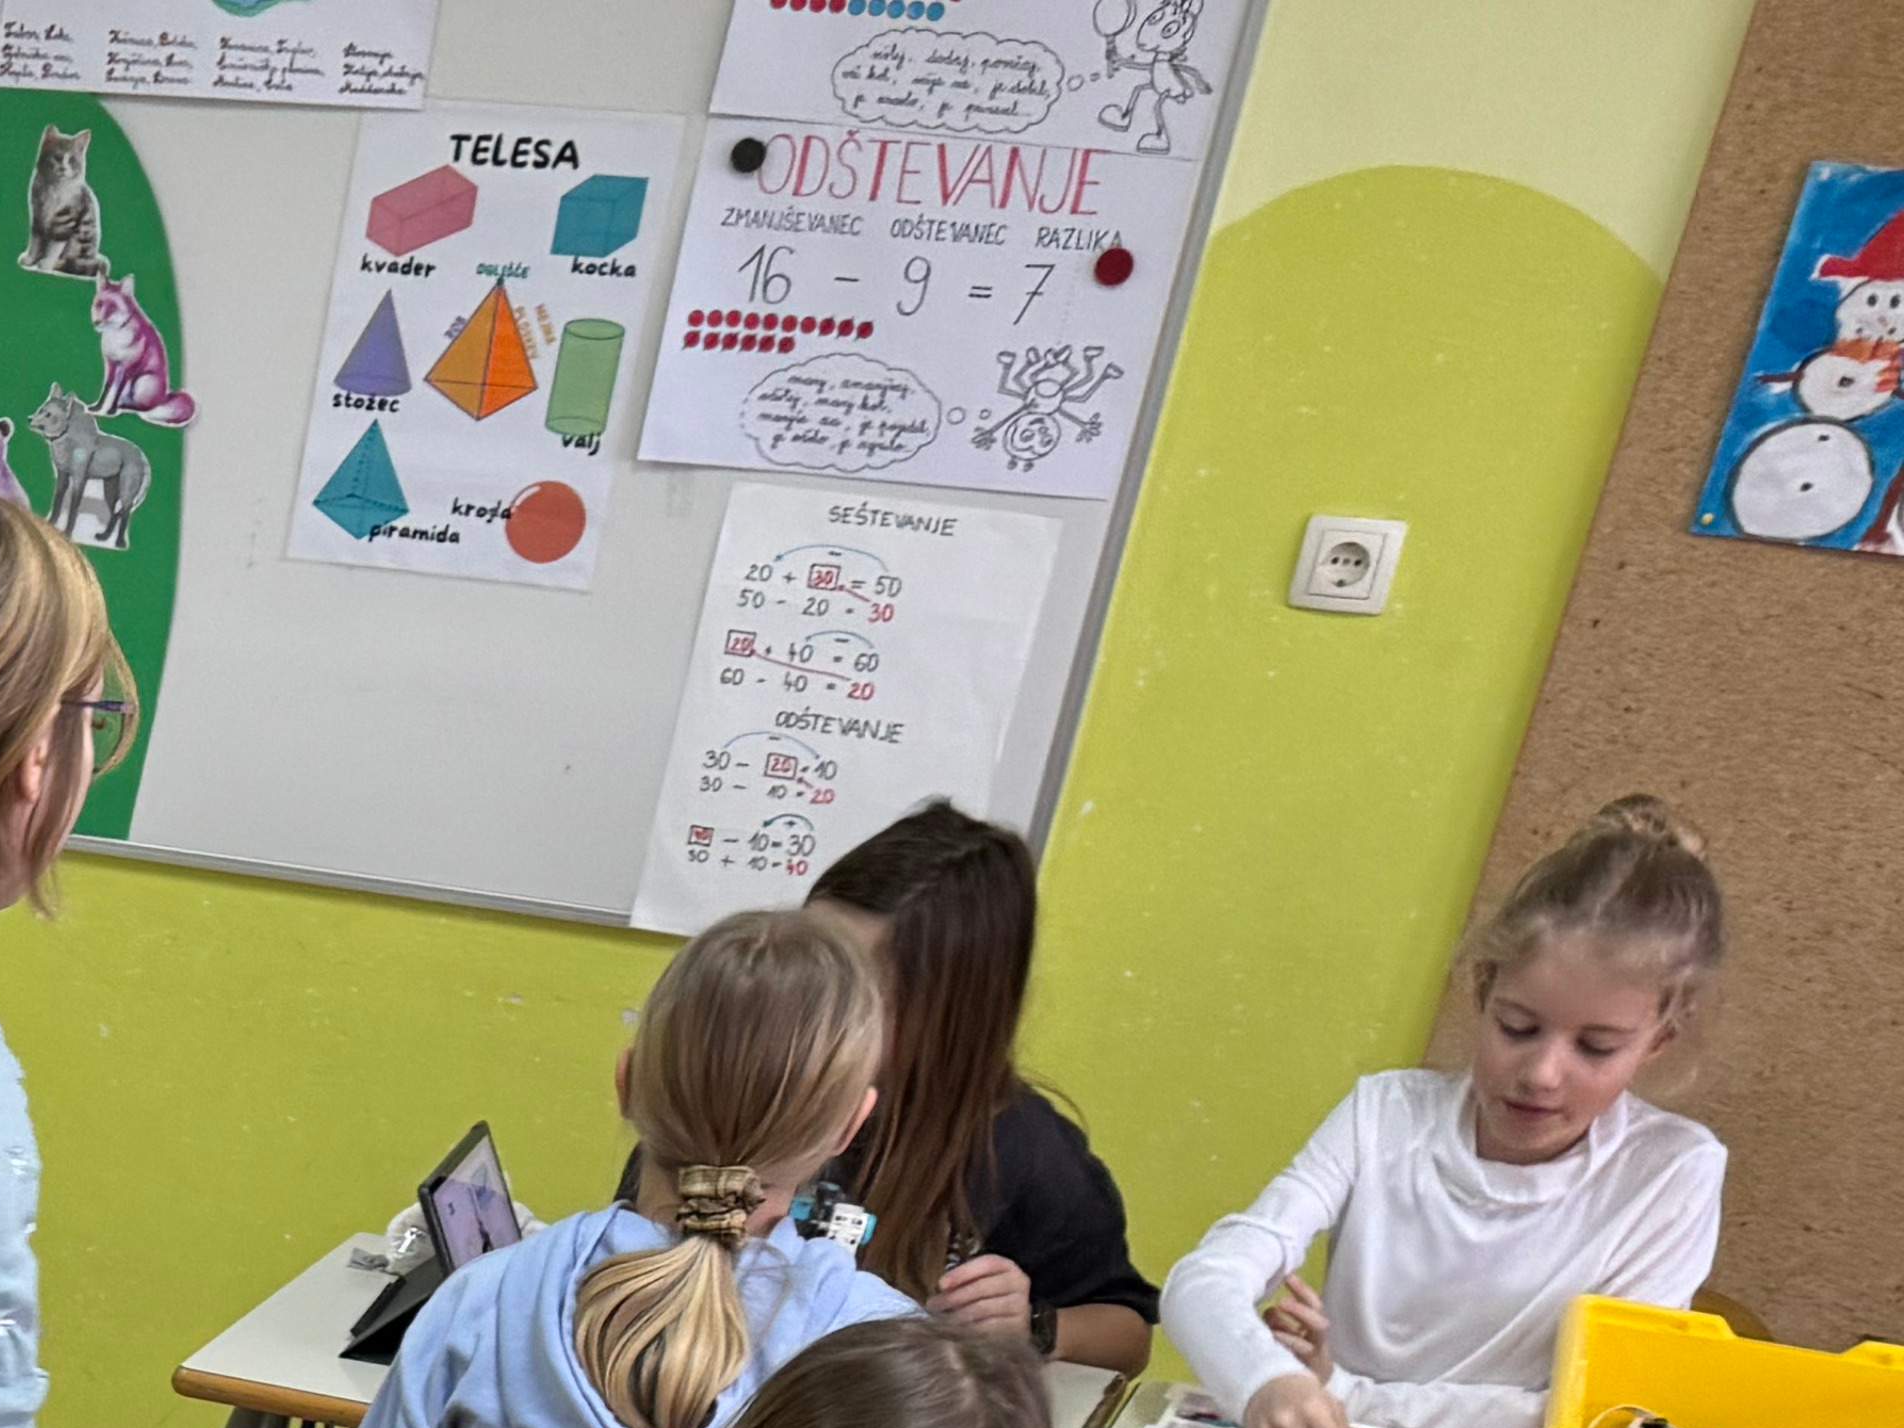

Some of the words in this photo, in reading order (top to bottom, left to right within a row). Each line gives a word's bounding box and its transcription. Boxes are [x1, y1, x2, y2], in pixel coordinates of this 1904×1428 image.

[449, 133, 581, 170] TELESA
[757, 129, 1110, 217] ODŠTEVANJE
[891, 213, 1010, 246] ODŠTEVANEC
[360, 253, 436, 279] kvader
[570, 255, 637, 279] kocka
[738, 243, 796, 305] 16
[897, 255, 932, 317] 9
[1012, 262, 1057, 327] 7
[332, 392, 400, 414] stožec
[561, 431, 603, 456] valj
[368, 520, 461, 545] piramida
[827, 501, 958, 538] SEŠTEVANJE
[744, 563, 773, 583] 20
[874, 575, 901, 598] 50
[736, 589, 765, 609] 50
[802, 598, 829, 617] 20
[867, 603, 895, 623] 30
[787, 643, 813, 664] 40
[853, 652, 880, 673] 60
[720, 668, 744, 686] 60
[783, 675, 808, 693] 40
[847, 681, 875, 700] 20
[774, 706, 906, 744] ODŠTEVANJE
[703, 750, 731, 770] 30
[699, 775, 723, 793] 30
[809, 788, 835, 805] 20
[787, 834, 816, 856] 30
